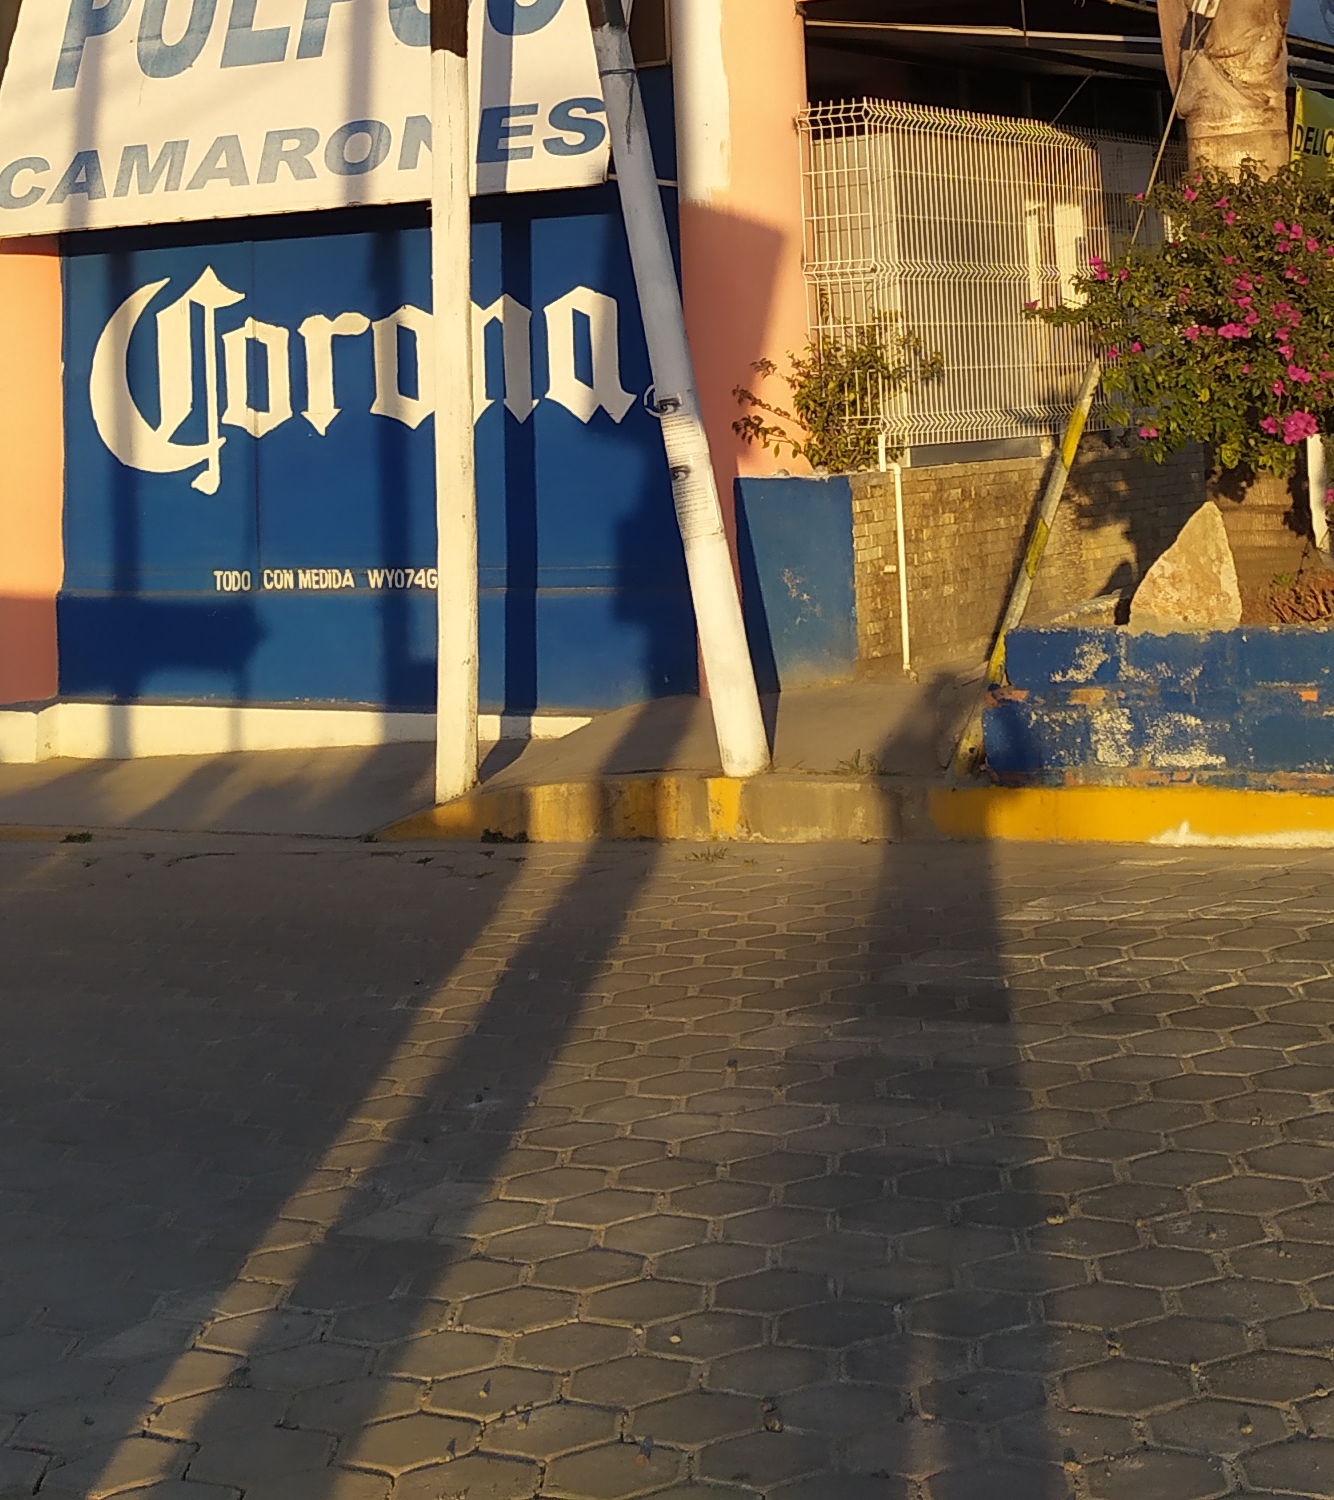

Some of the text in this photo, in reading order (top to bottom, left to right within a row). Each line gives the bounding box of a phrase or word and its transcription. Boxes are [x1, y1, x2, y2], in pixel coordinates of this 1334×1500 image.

[89, 263, 639, 497] Corona
[212, 569, 252, 592] TODO
[263, 569, 295, 591] CON
[297, 569, 356, 590] MEDIDA
